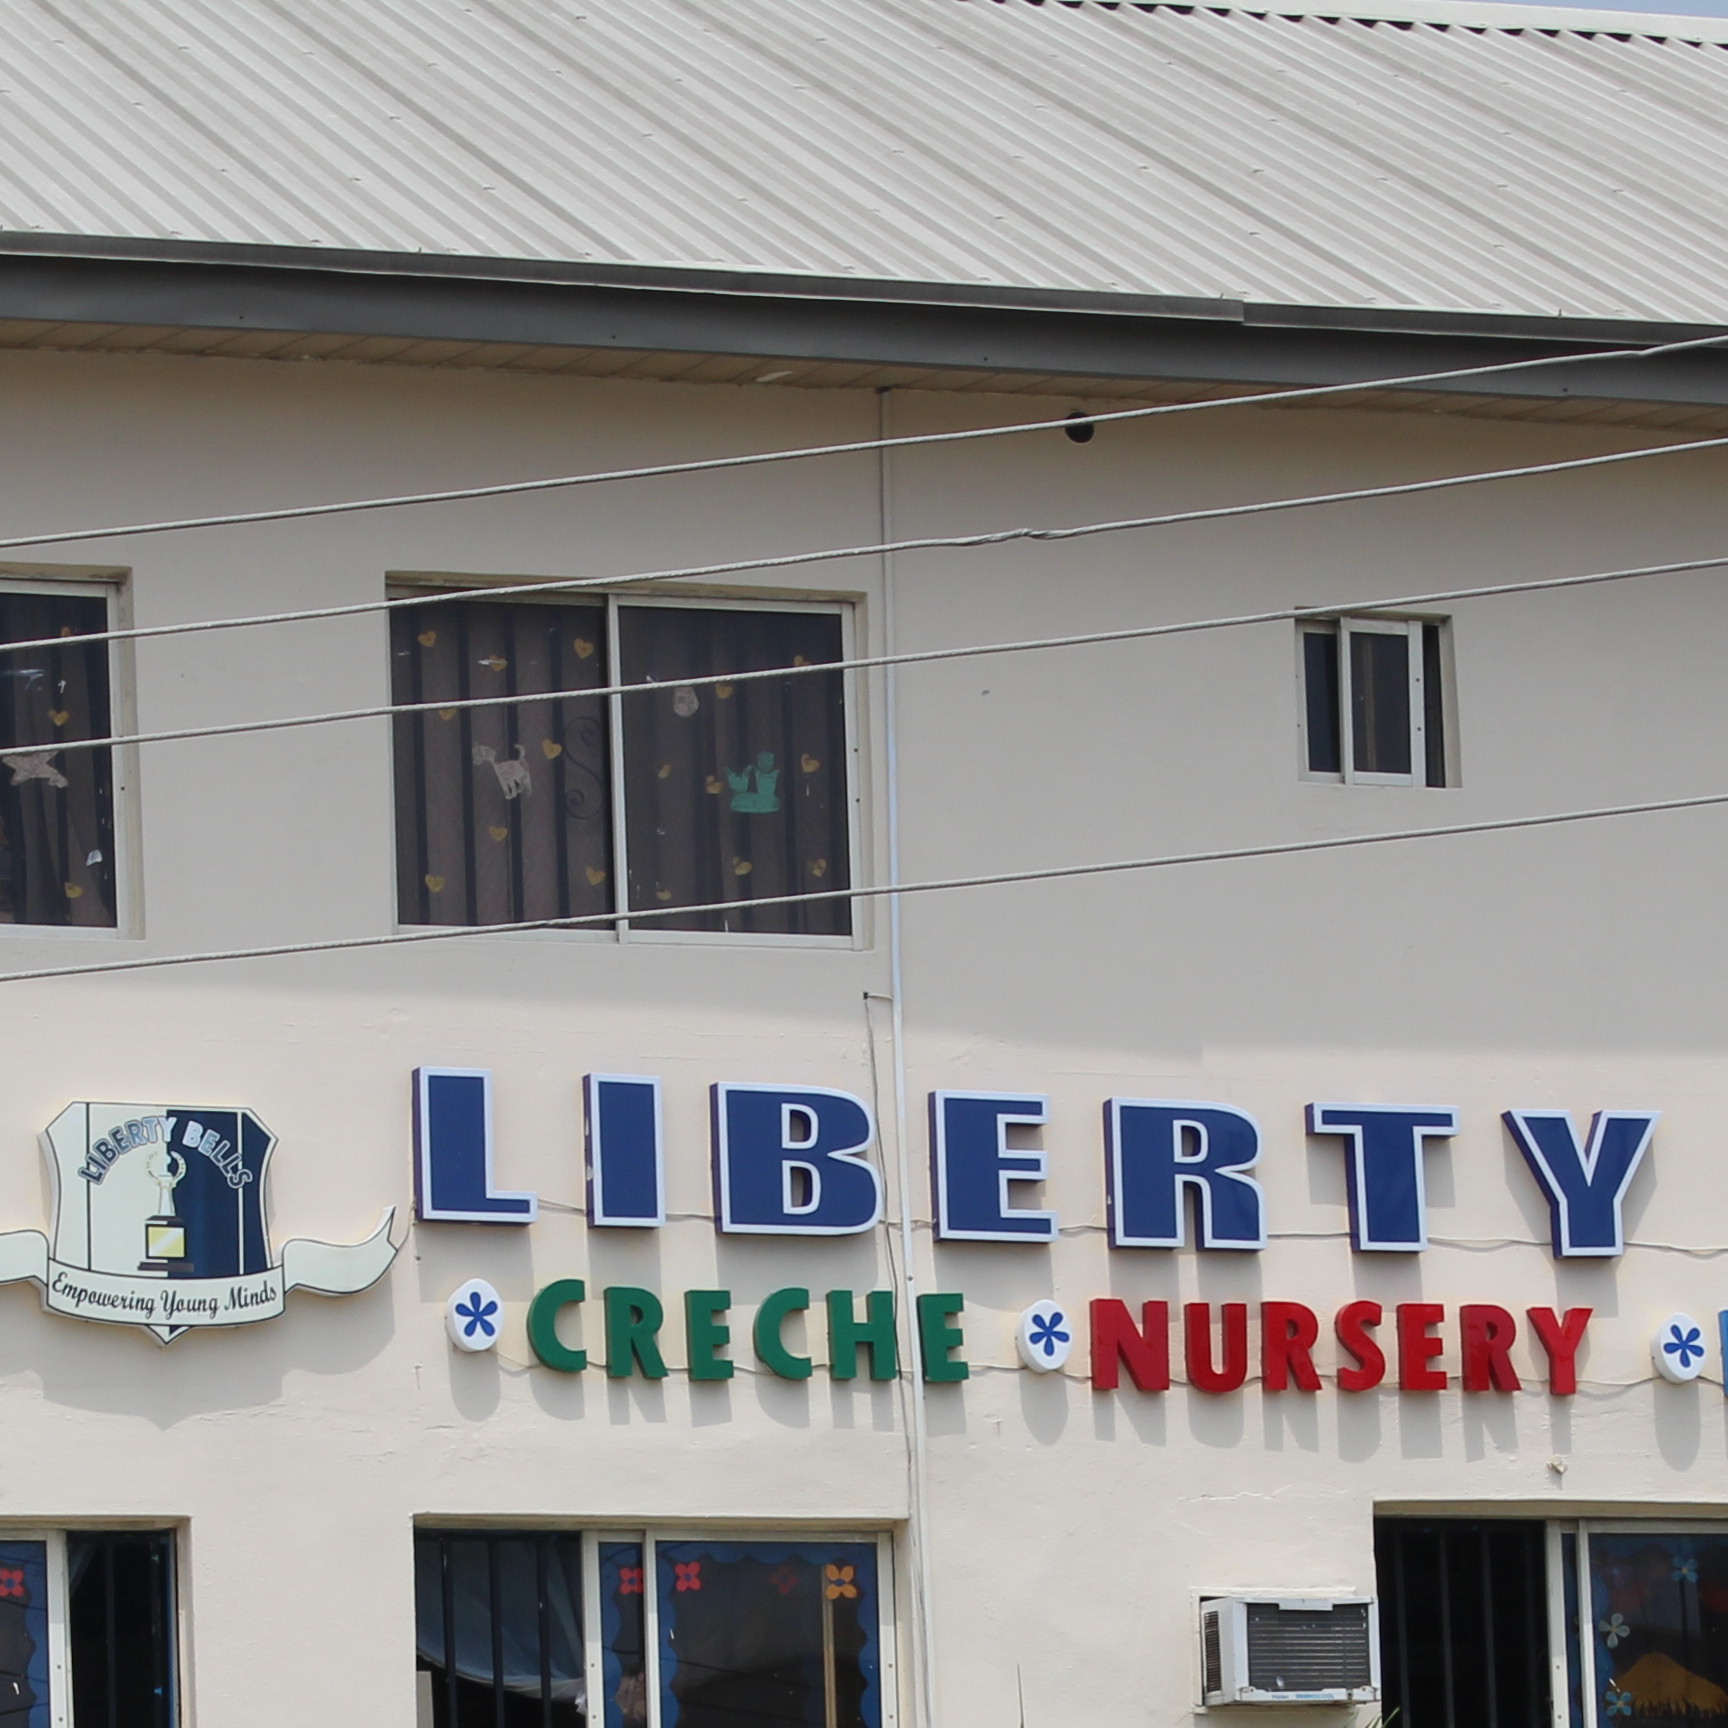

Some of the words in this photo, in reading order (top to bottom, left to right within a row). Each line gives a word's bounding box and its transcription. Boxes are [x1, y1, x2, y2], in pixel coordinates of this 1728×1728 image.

[78, 1116, 177, 1185] LIBERTY
[182, 1120, 253, 1189] BELLS
[412, 1066, 1661, 1259] LIBERTY
[51, 1271, 155, 1319] Empowering
[160, 1289, 219, 1320] Young
[224, 1280, 277, 1310] Minds
[526, 1279, 969, 1382] CRECHE
[1089, 1298, 1593, 1396] NURSERY
